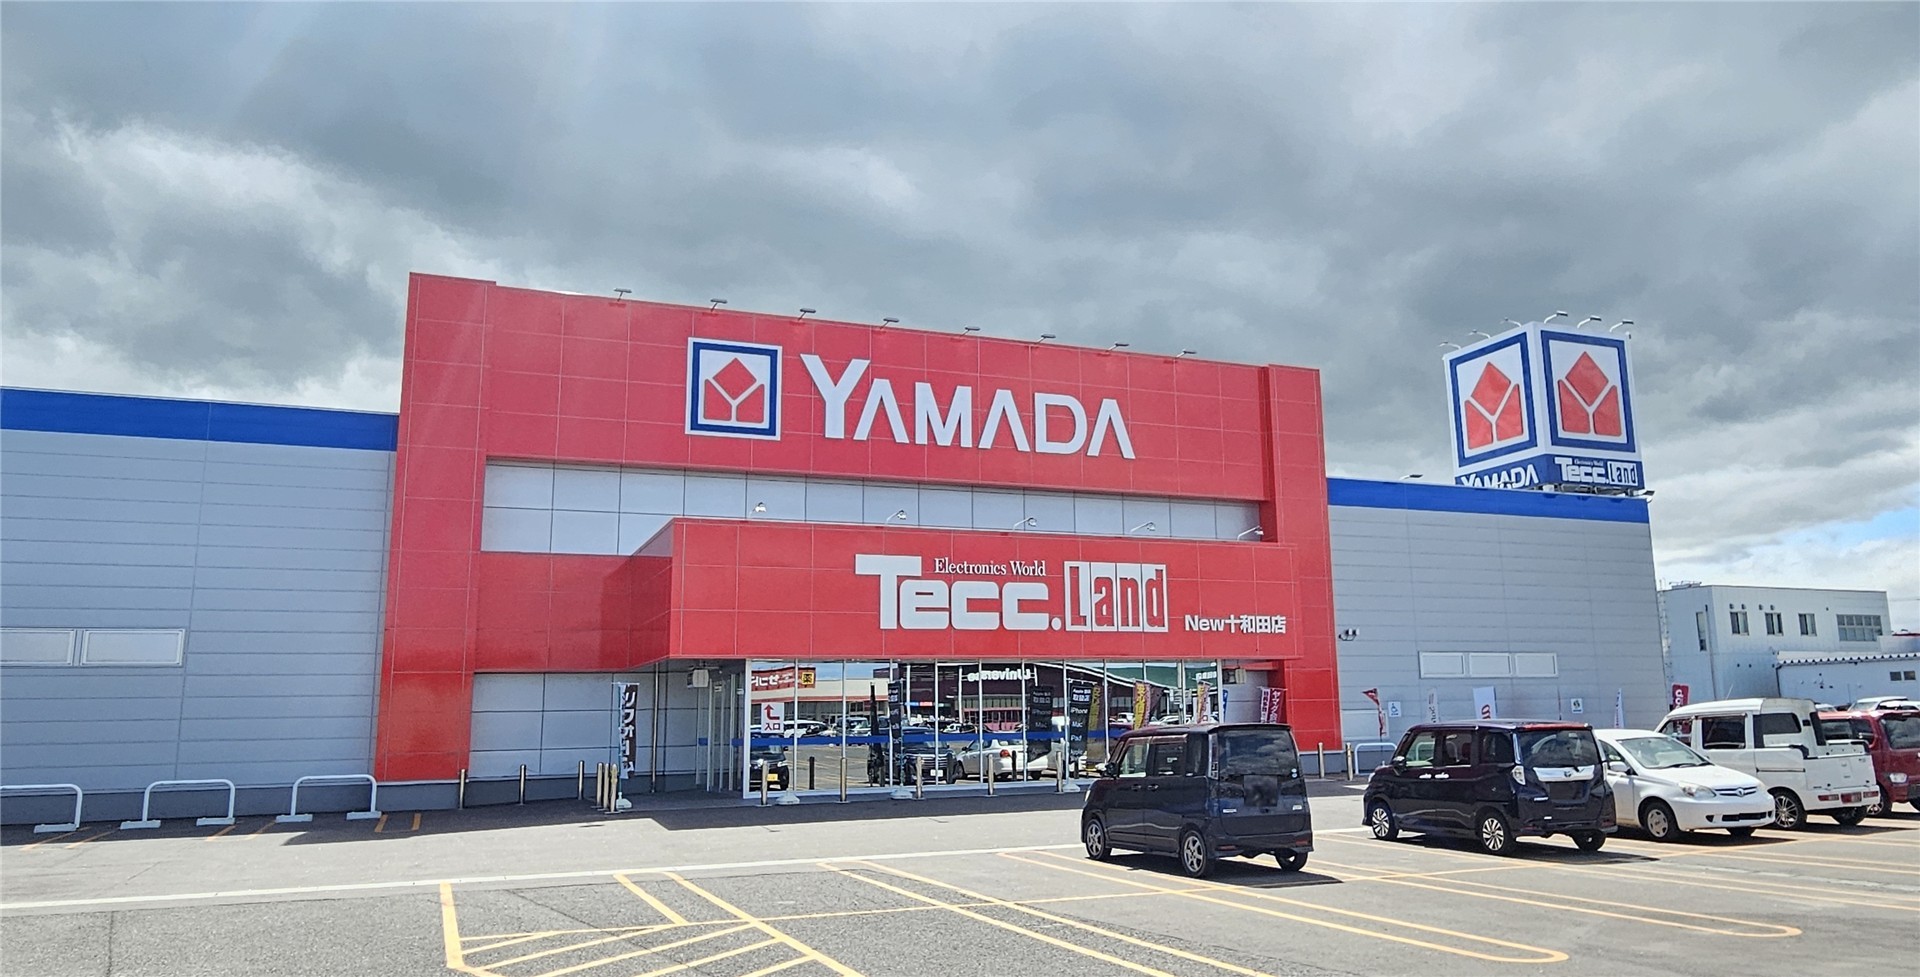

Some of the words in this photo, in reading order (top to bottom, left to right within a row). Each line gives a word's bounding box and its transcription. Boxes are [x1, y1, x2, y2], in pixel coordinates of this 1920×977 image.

[800, 353, 1136, 459] YAMADA
[934, 557, 1007, 576] Electronics
[1009, 559, 1047, 577] World
[764, 722, 781, 731] 入口
